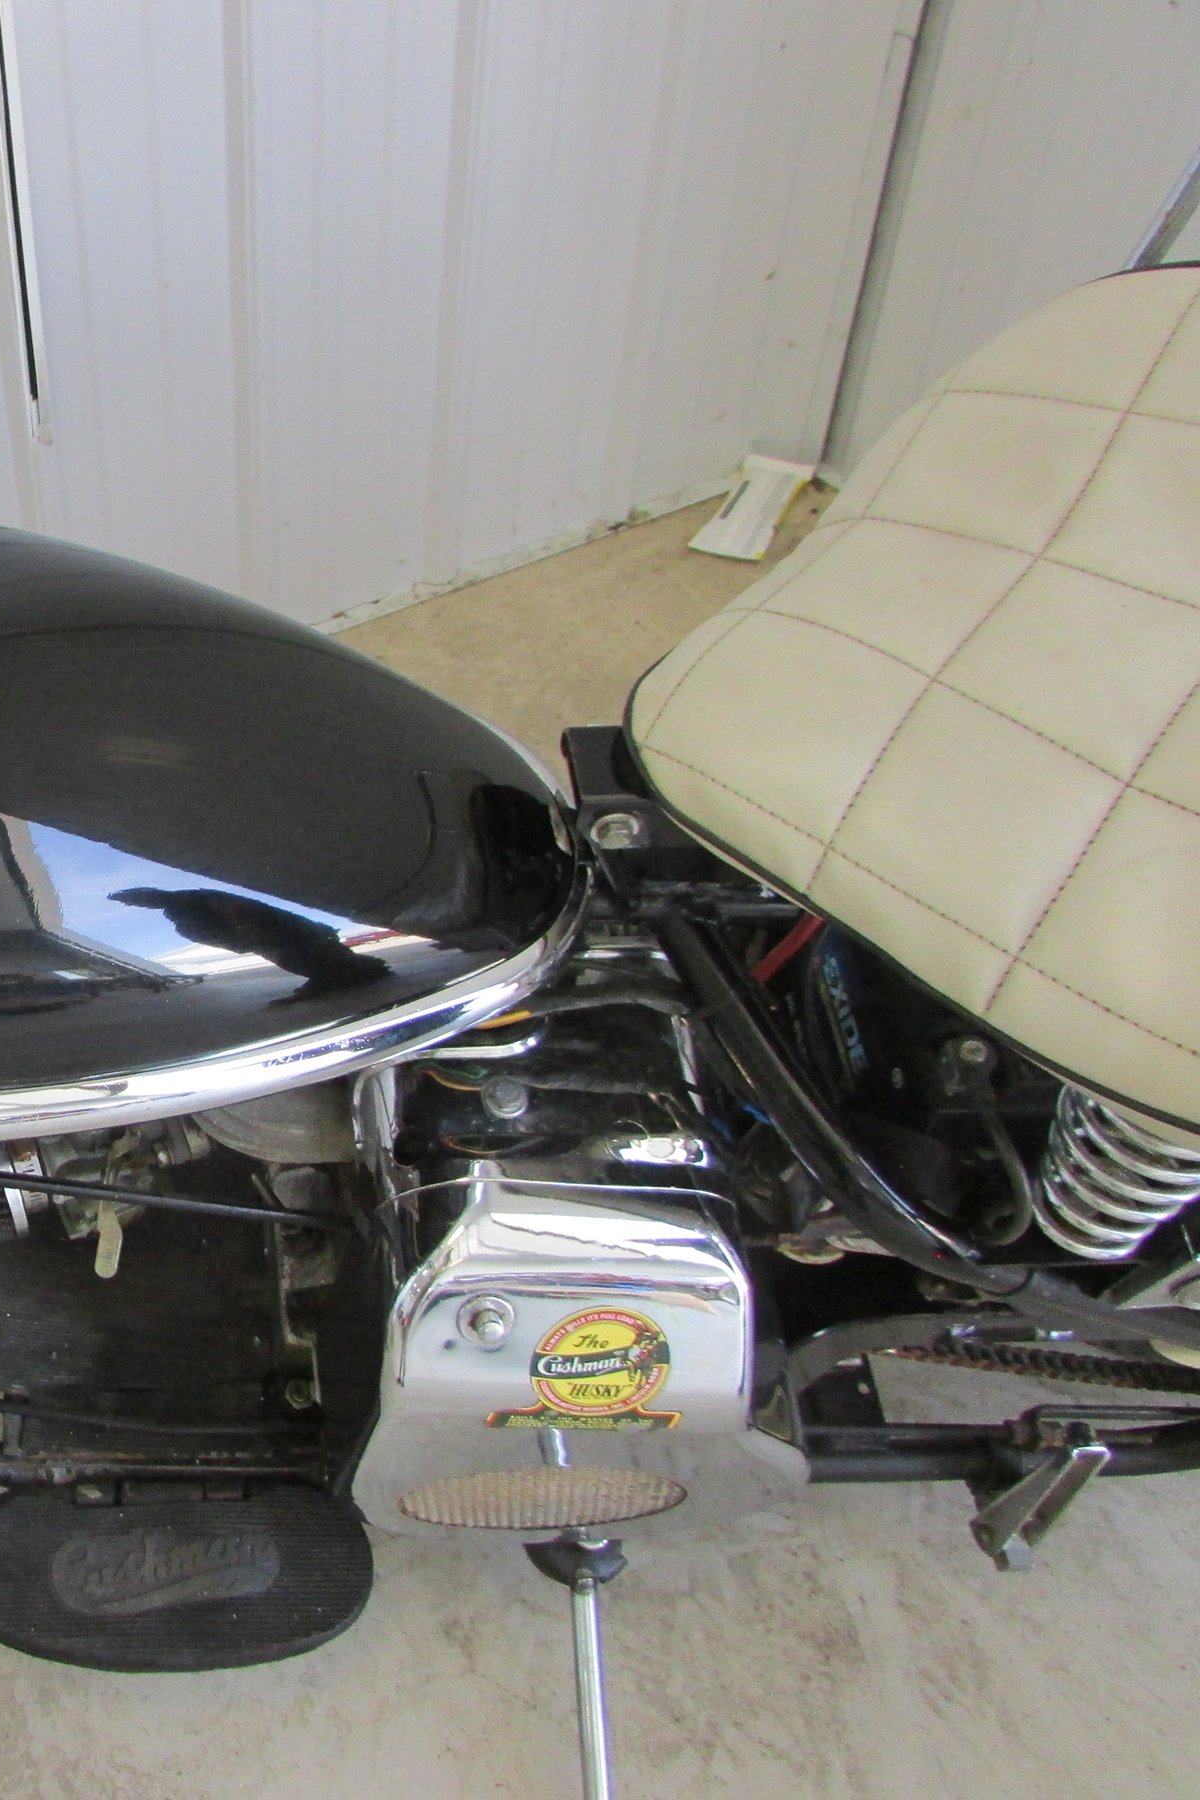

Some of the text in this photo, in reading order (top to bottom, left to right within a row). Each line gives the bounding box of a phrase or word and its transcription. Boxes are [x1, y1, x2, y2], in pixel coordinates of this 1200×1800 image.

[823, 954, 868, 1075] EXIDE
[573, 1333, 610, 1349] The
[537, 1354, 623, 1376] Cushman
